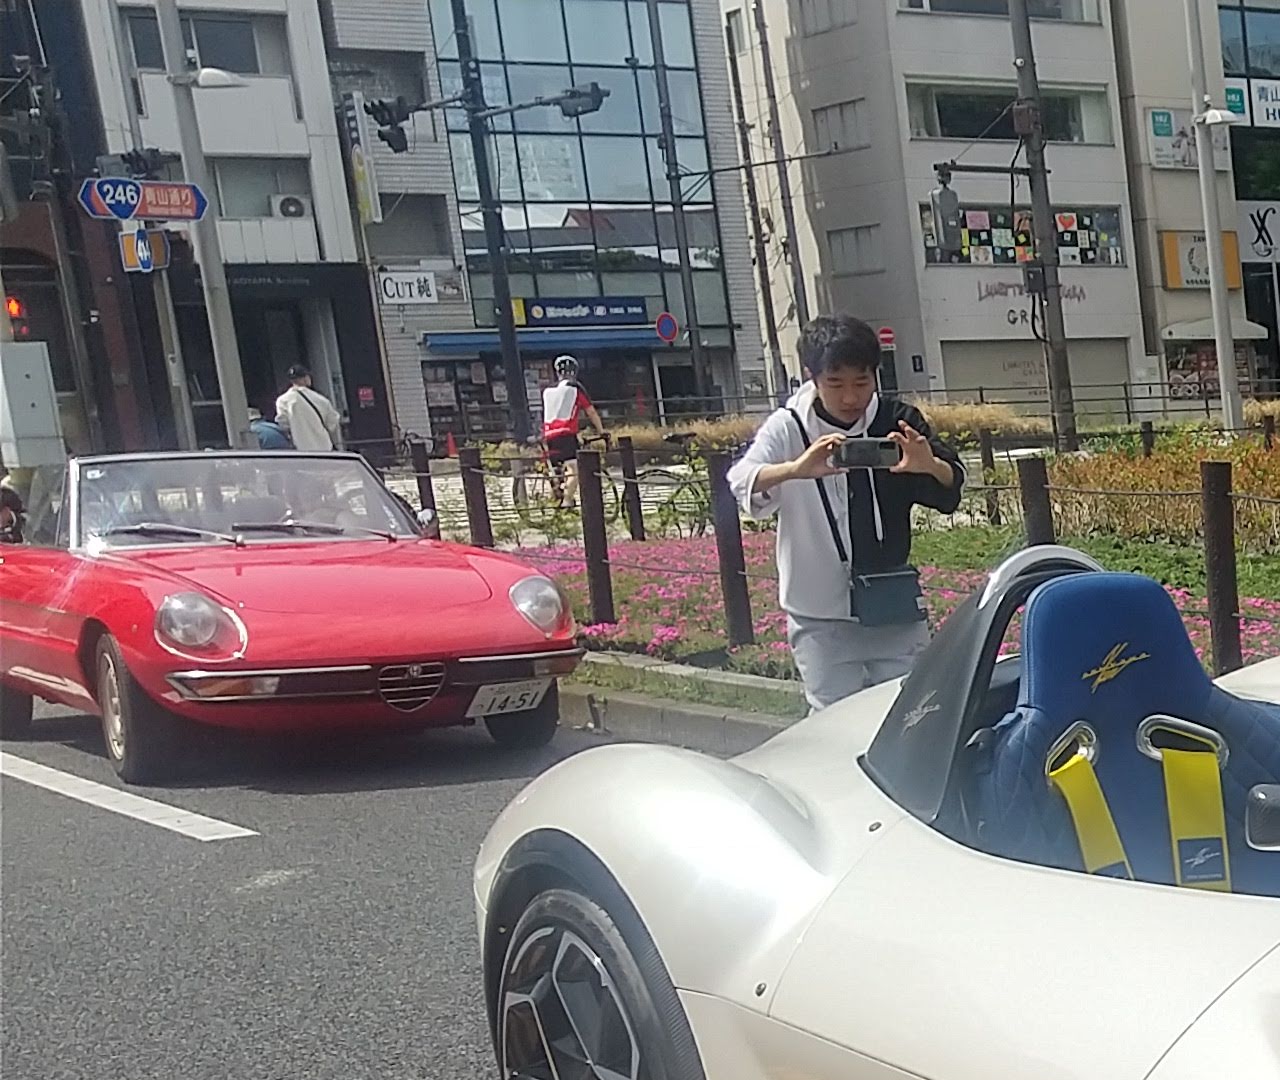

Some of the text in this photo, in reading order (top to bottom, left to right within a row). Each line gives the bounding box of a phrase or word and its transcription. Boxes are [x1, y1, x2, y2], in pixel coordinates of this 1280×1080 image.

[103, 183, 139, 205] 246
[383, 276, 415, 299] CUT
[486, 691, 540, 714] 14-51
